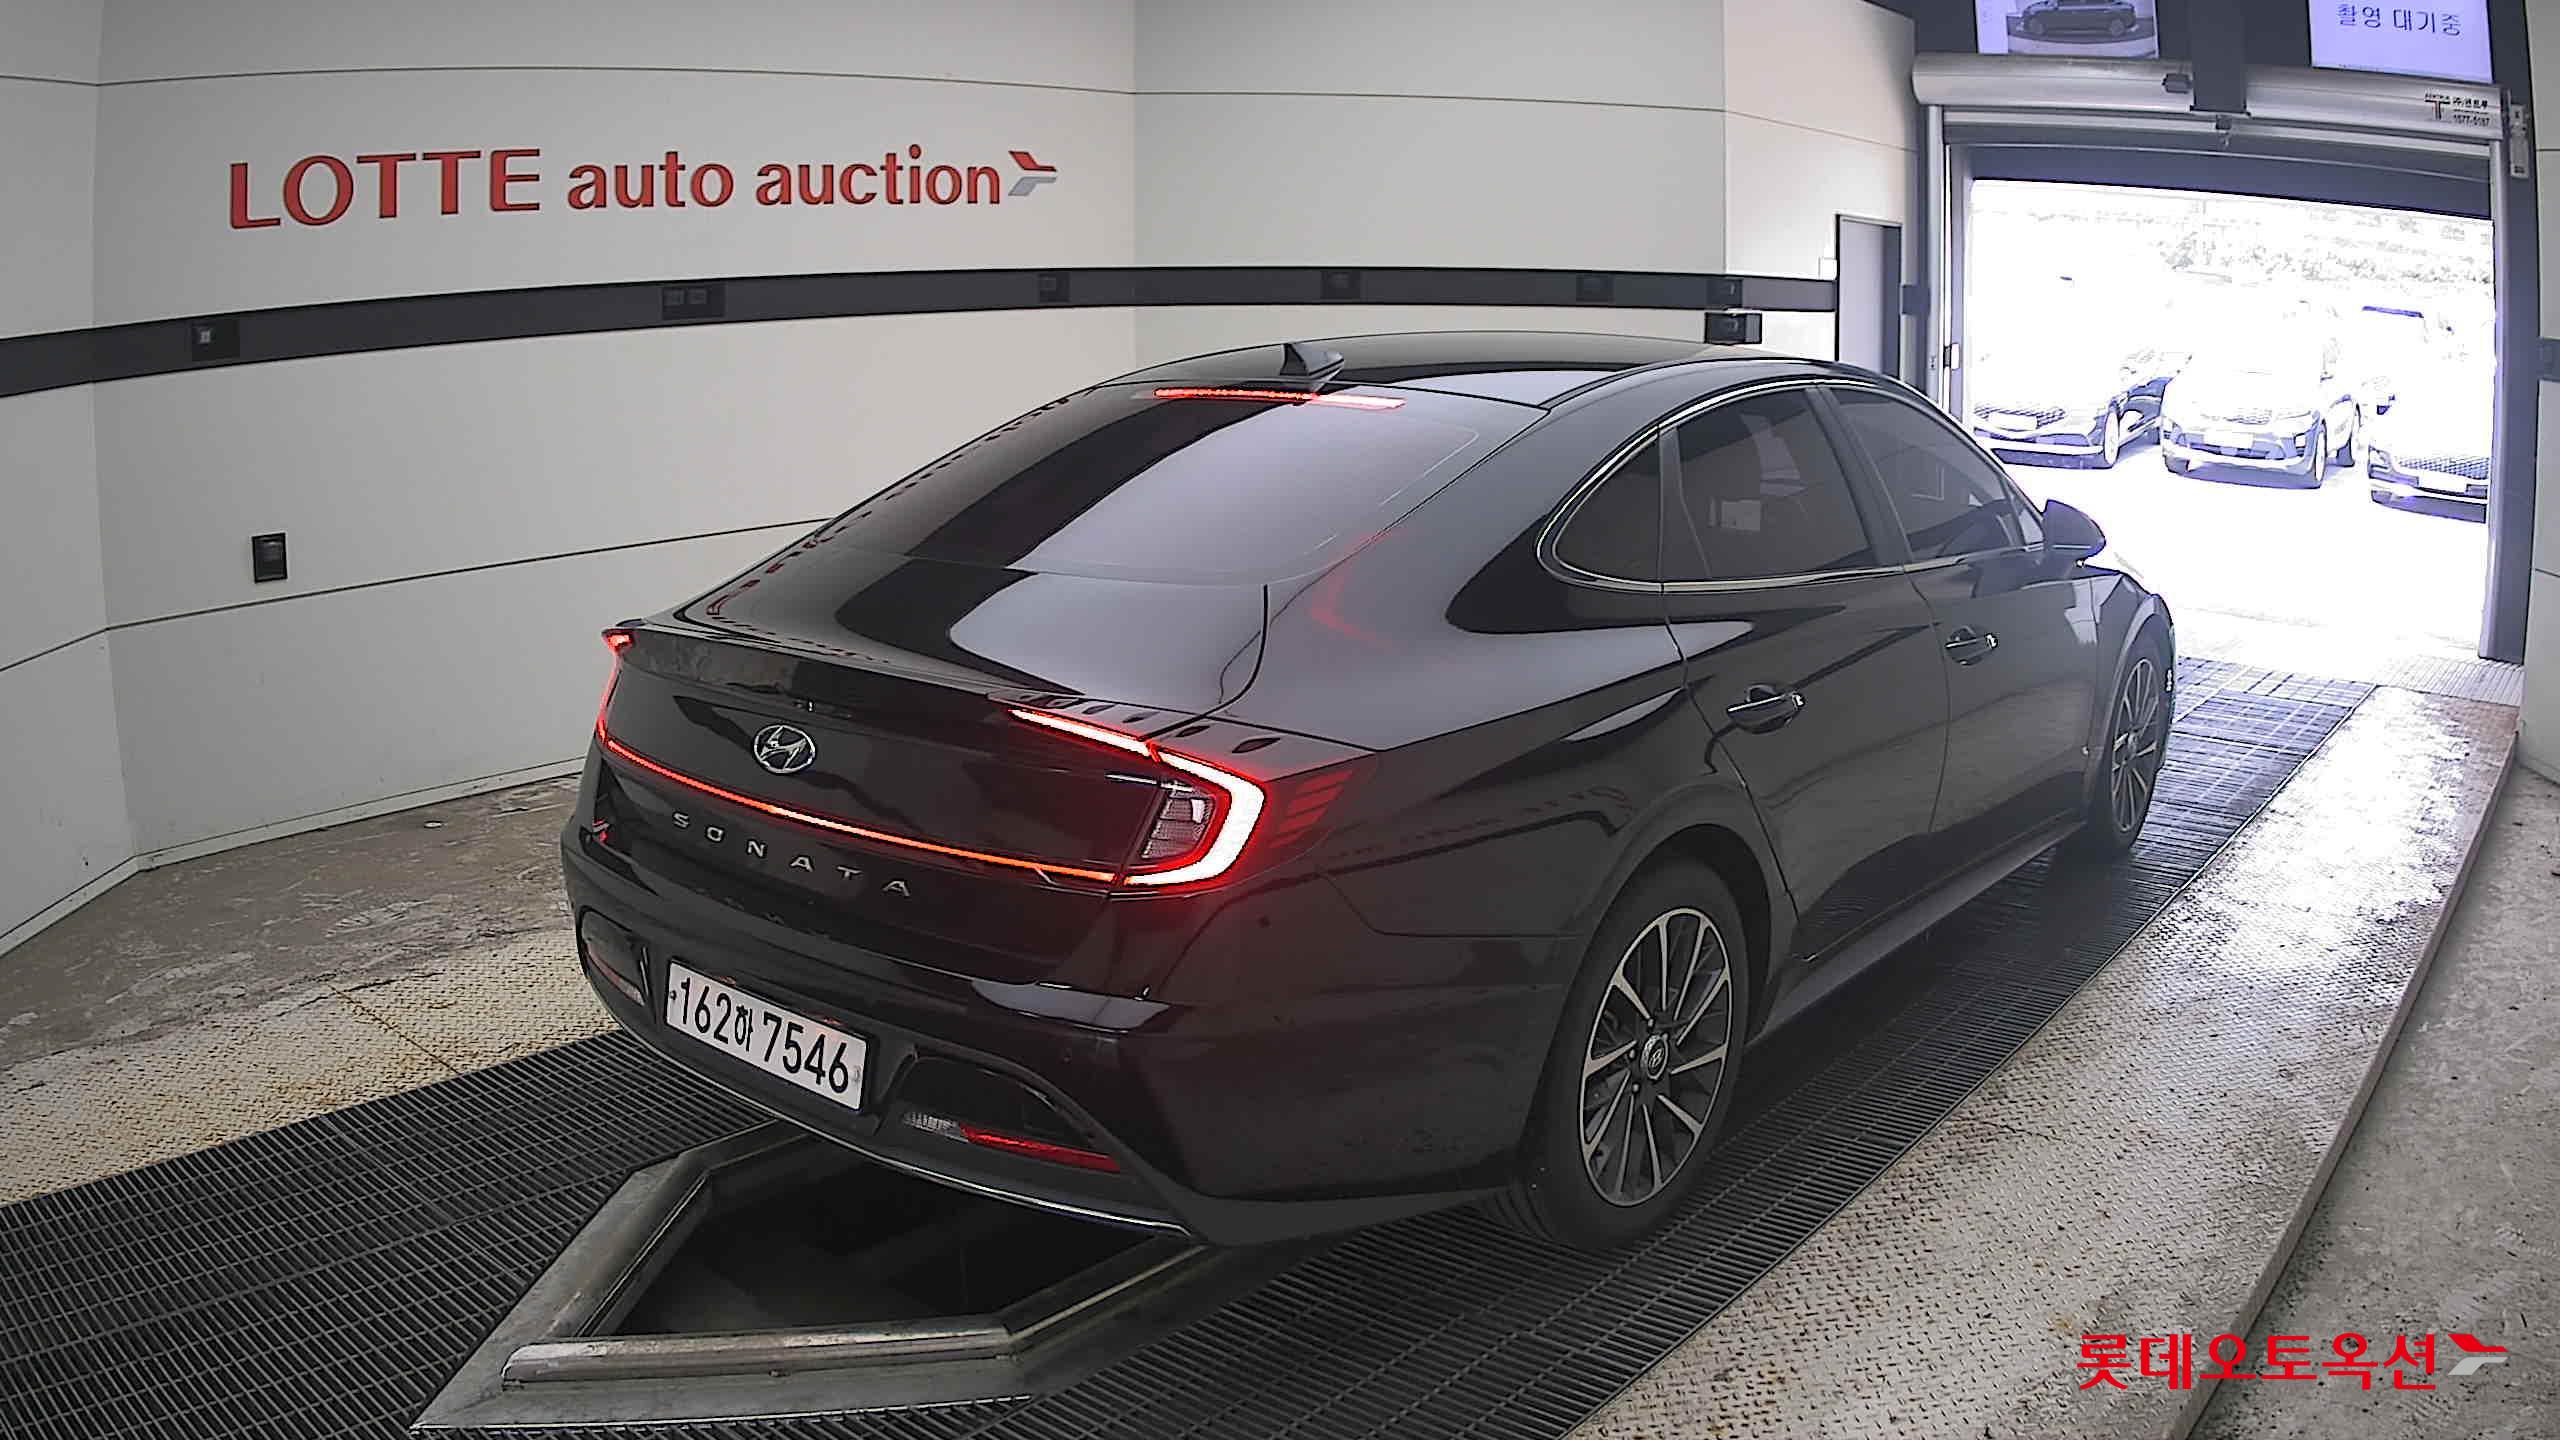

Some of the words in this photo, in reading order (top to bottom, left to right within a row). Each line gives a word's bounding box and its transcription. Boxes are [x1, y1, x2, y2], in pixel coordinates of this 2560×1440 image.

[2338, 4, 2382, 28] 촬영
[2393, 9, 2461, 36] 대기중
[230, 148, 541, 229] LOTTE
[567, 151, 735, 209] auto
[756, 144, 1001, 206] auction
[672, 811, 911, 897] SONATA
[681, 977, 753, 1052] 162하
[763, 1012, 848, 1093] 7546
